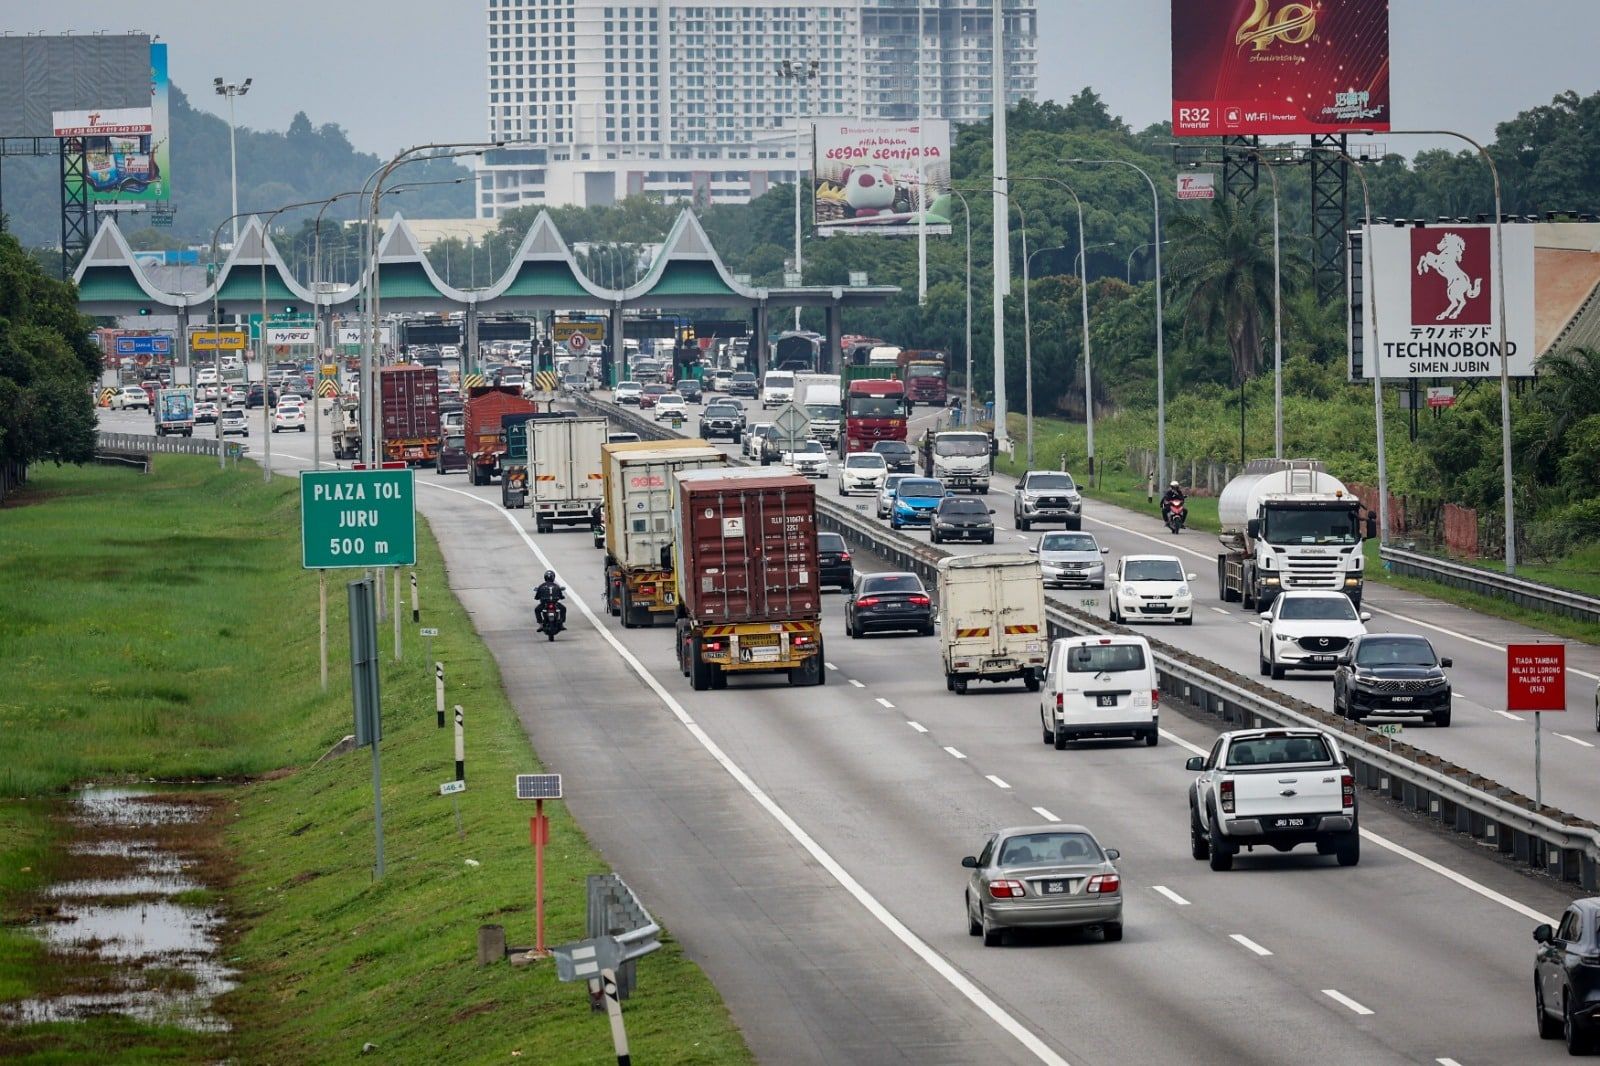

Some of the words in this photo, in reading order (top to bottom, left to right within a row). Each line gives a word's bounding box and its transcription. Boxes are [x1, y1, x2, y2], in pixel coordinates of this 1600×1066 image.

[1179, 108, 1210, 121] R32
[826, 146, 868, 160] segar
[275, 333, 310, 342] MyRFID
[1383, 341, 1517, 358] TECHNOBOND
[1409, 361, 1448, 373] SIMEN
[1452, 361, 1489, 372] JUBIN
[314, 483, 365, 500] PLAZA
[374, 482, 401, 499] TOL
[339, 510, 378, 527] JURU
[330, 538, 364, 555] 500
[375, 541, 388, 553] m
[741, 648, 753, 662] KA
[1537, 666, 1560, 674] LORONG
[1275, 819, 1287, 827] JRU
